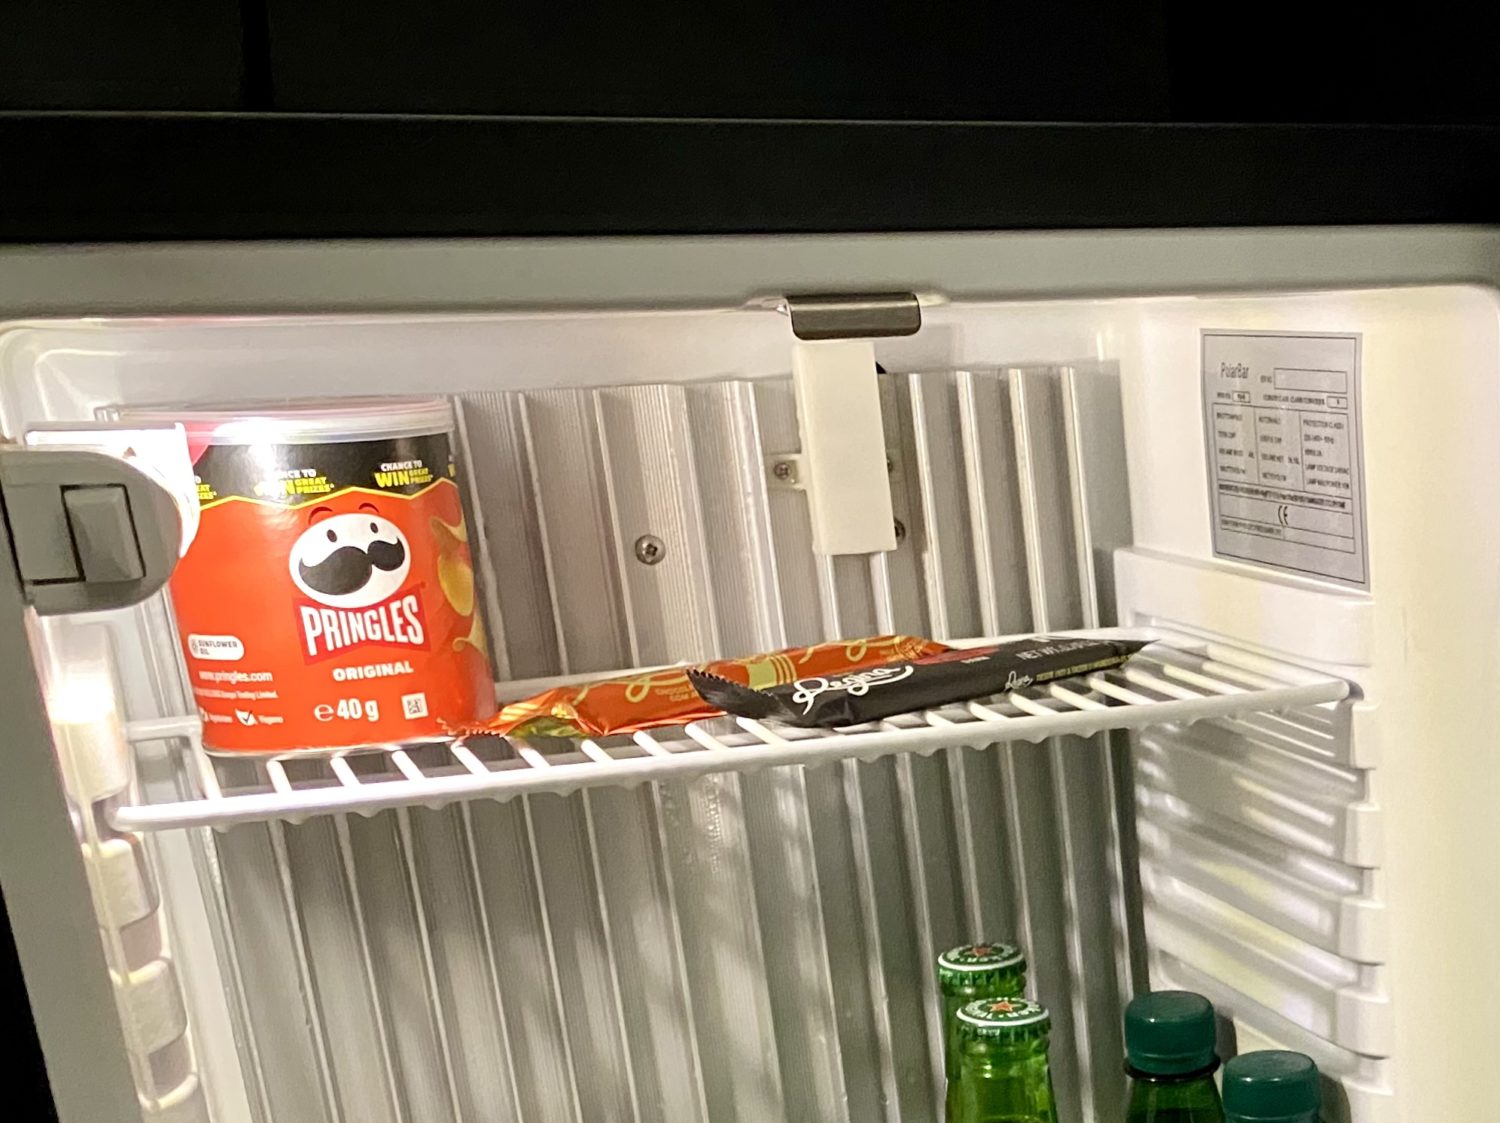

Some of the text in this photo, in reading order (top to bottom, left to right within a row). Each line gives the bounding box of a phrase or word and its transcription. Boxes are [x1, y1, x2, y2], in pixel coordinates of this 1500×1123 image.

[380, 459, 423, 472] CHANCE TO
[295, 476, 327, 486] GREAT
[301, 469, 317, 478] TO
[374, 470, 410, 488] WIN
[300, 594, 425, 657] PRINGLES
[198, 639, 238, 648] SUNFLOWER
[332, 660, 414, 682] ORIGINAL
[337, 697, 363, 721] 40
[364, 699, 380, 723] g
